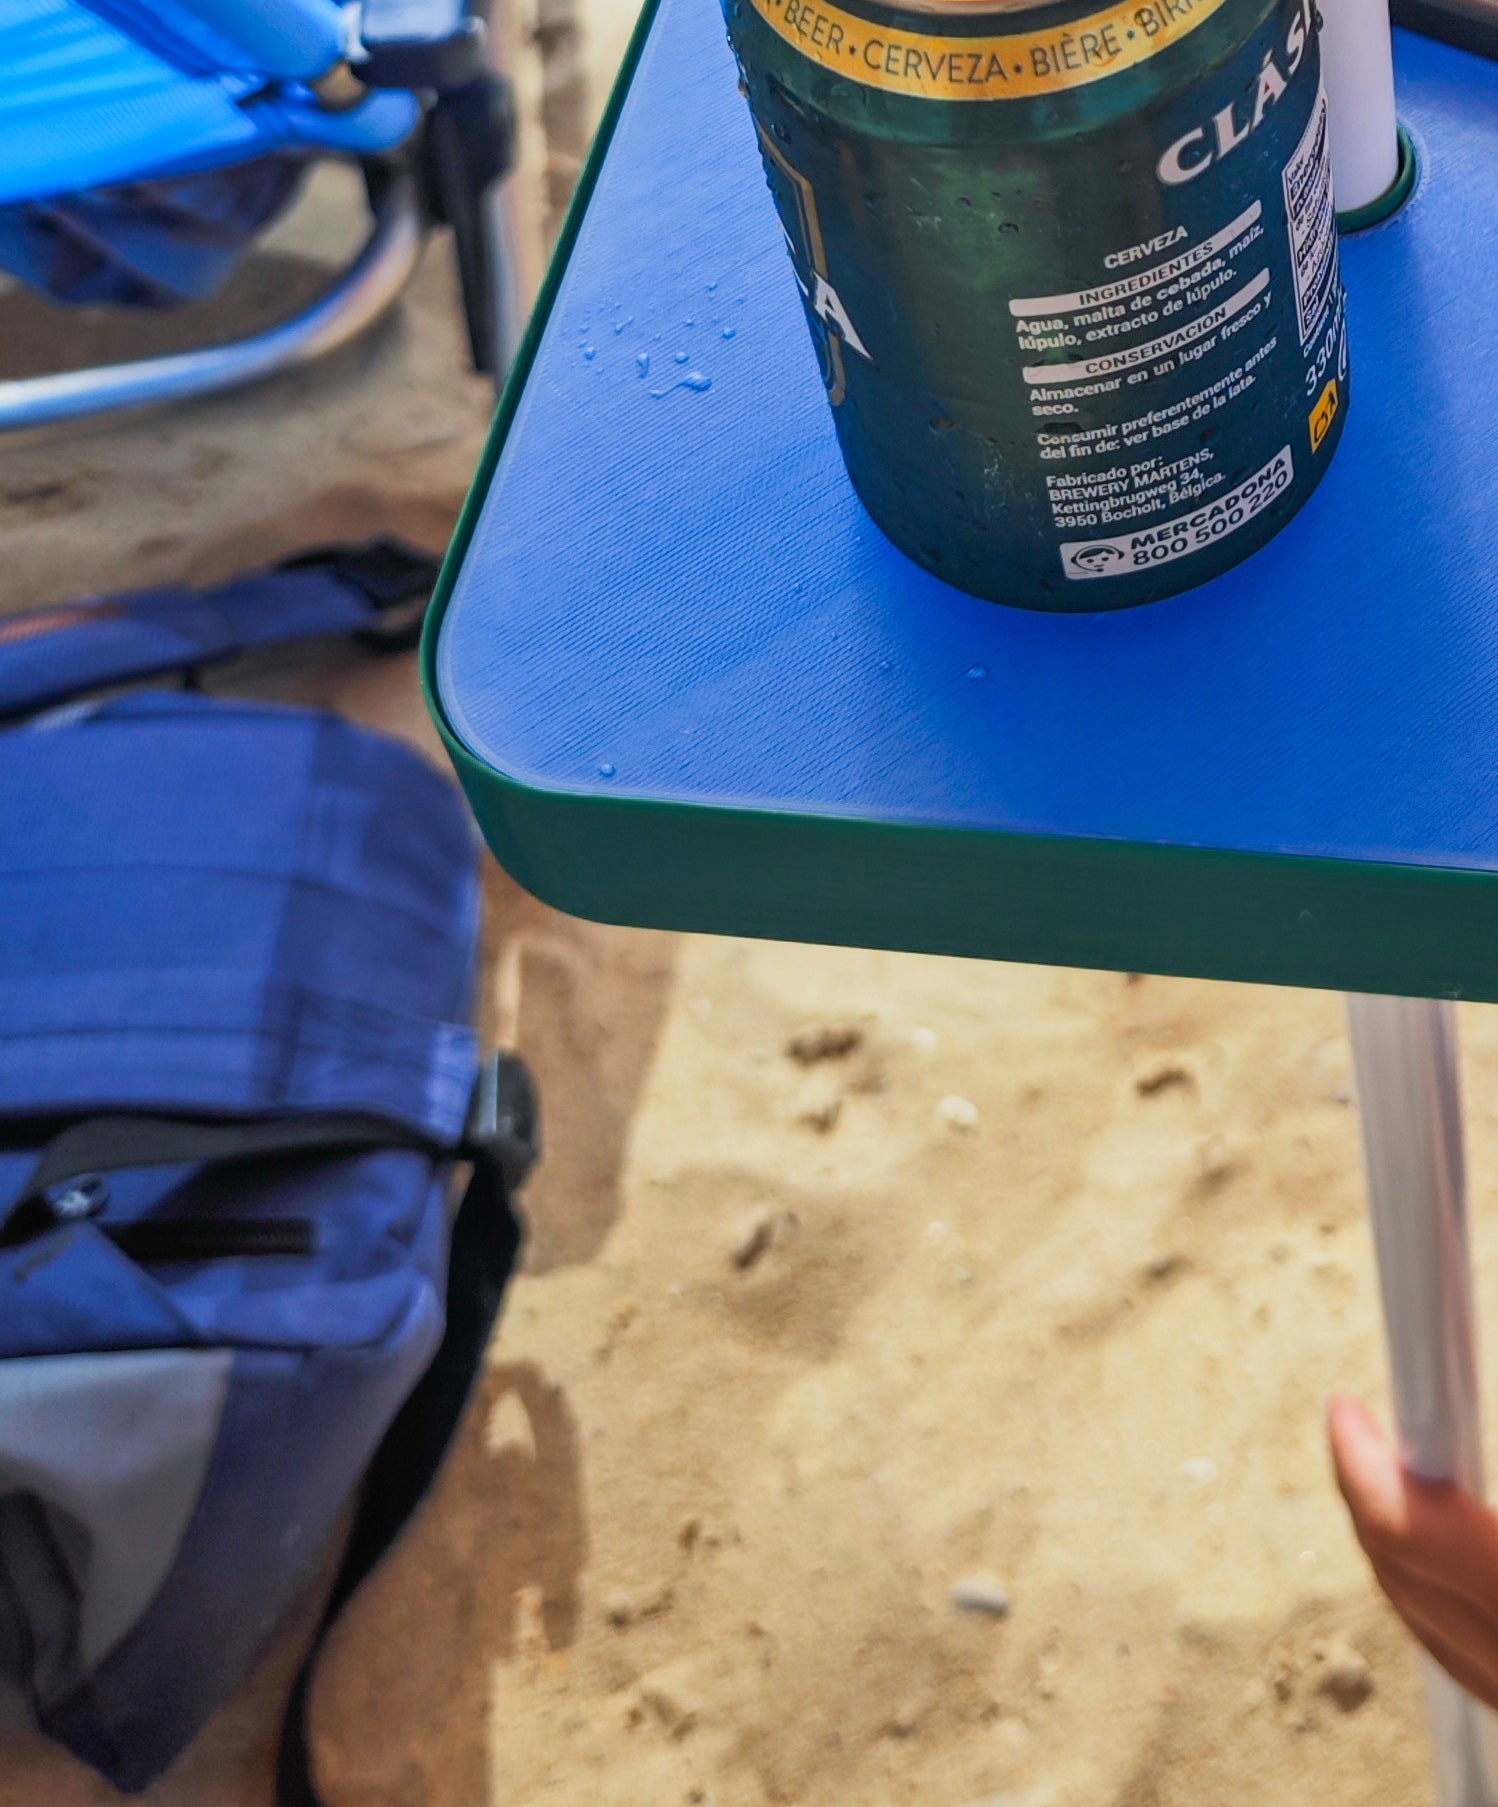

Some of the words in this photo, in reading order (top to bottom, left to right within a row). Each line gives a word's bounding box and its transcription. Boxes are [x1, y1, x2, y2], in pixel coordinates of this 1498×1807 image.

[863, 39, 1008, 84] CERVEZA
[1029, 24, 1122, 77] BIÈRE
[1079, 241, 1214, 306] INGREDIENTES
[1104, 225, 1189, 269] CERVEZA
[1016, 318, 1069, 338] Agua,
[1073, 301, 1126, 328] malta
[1130, 295, 1153, 312] de
[1156, 259, 1226, 301] cebada,
[1018, 333, 1082, 352] lúpulo,
[1085, 311, 1159, 342] extracto
[1162, 296, 1184, 314] de
[1187, 268, 1238, 305] lúpulo.
[1030, 375, 1122, 402] Almacenar
[1127, 371, 1149, 385] en
[1153, 360, 1176, 376] un
[1179, 335, 1218, 365] lugar
[1220, 305, 1262, 340] fresco
[1263, 290, 1273, 309] y
[1032, 402, 1080, 417] seco.
[1036, 423, 1120, 447] Consumir
[1121, 366, 1244, 435] preferentemente
[1244, 335, 1279, 373] antes
[1039, 445, 1067, 461] del
[1068, 442, 1093, 458] fin
[1094, 437, 1121, 454] de:
[1123, 430, 1150, 448] ver
[1150, 416, 1191, 439] base
[1192, 402, 1212, 421] de
[1212, 394, 1228, 410] la
[1228, 374, 1258, 401] lata.
[1046, 467, 1128, 488] Fabricado
[1130, 455, 1164, 478] por:
[1048, 478, 1130, 502] BREWERY
[1133, 446, 1216, 489] MARTENS,
[1051, 479, 1178, 515] Kettingbrugweg
[1130, 457, 1287, 550] MERCADONA
[1054, 513, 1098, 528] 3950
[1101, 496, 1168, 524] Bocholt,
[1132, 536, 1188, 566] 800
[1194, 509, 1244, 544] 500
[1248, 470, 1288, 514] 220
